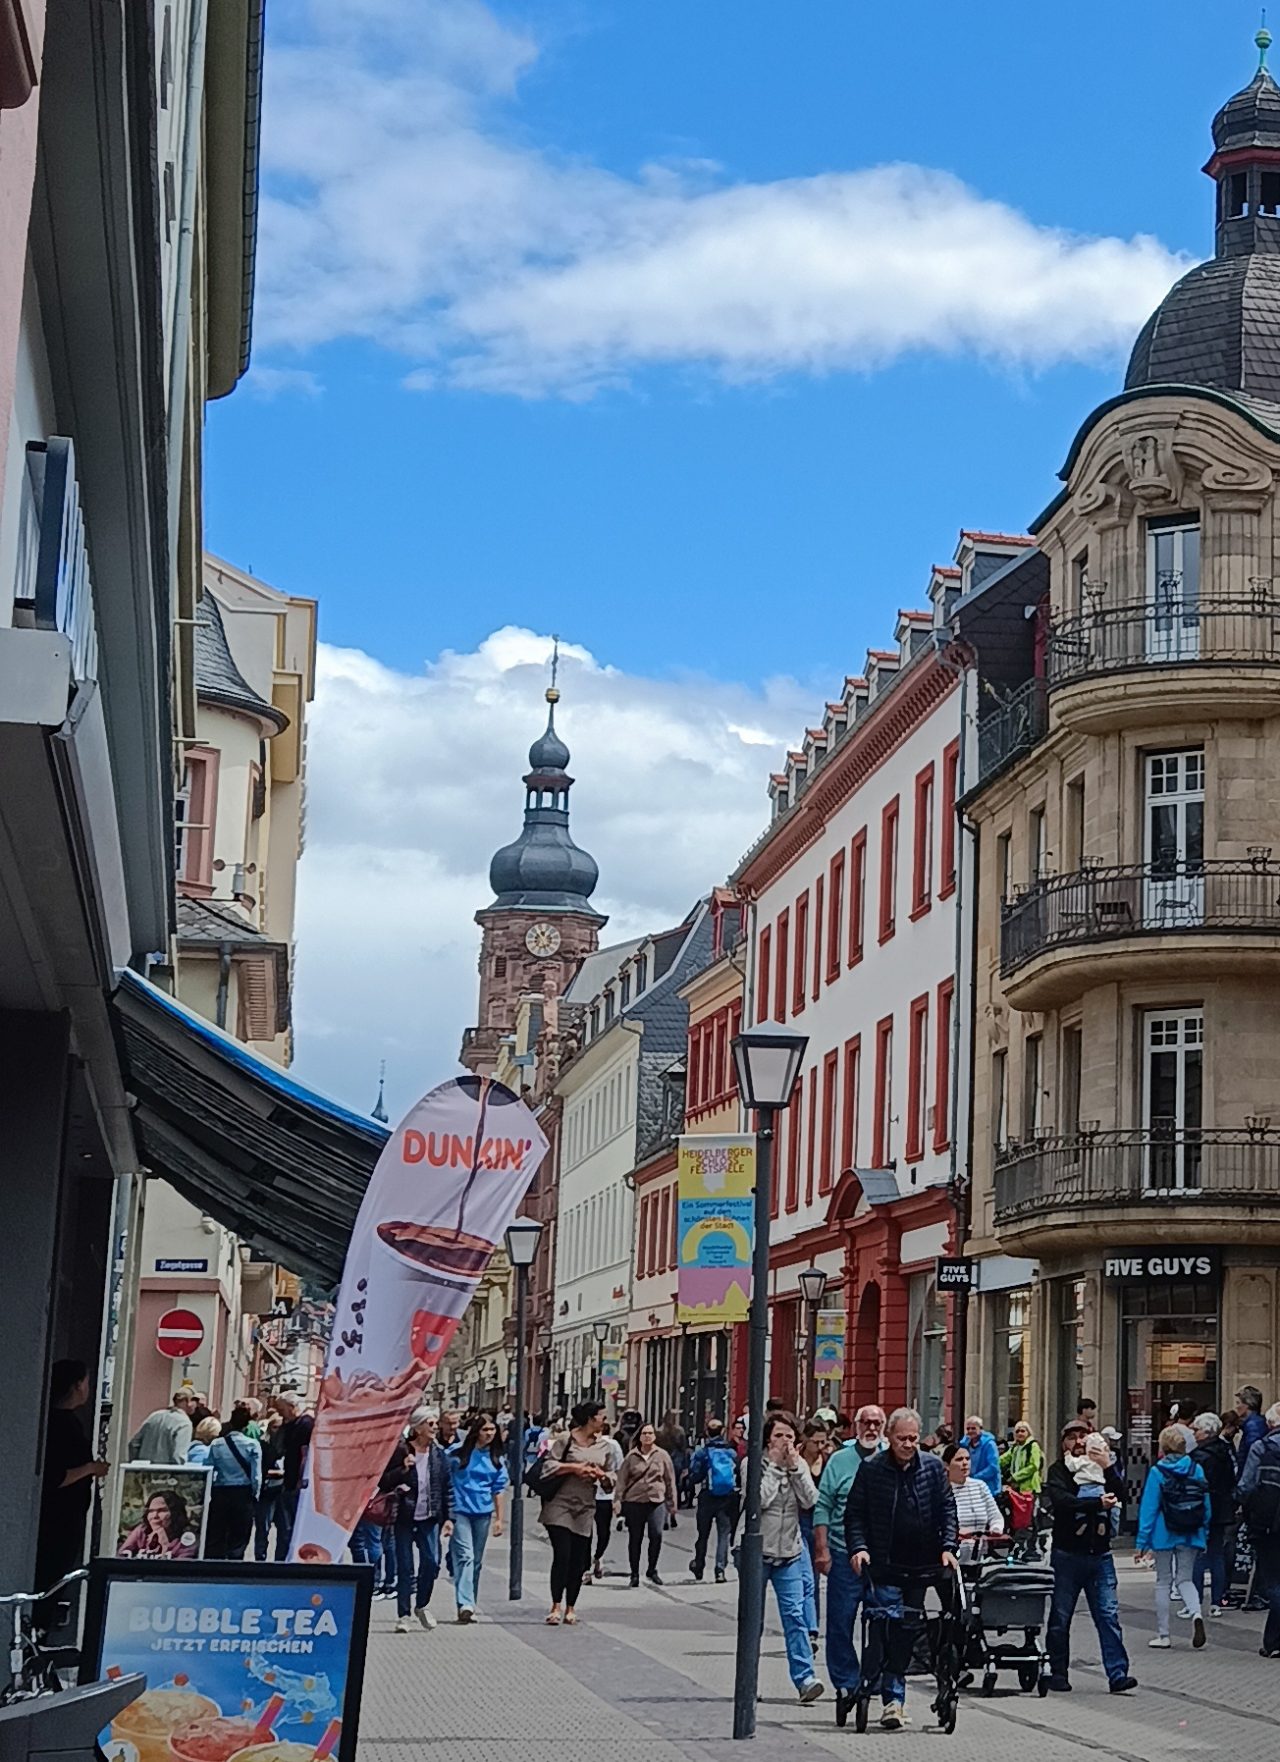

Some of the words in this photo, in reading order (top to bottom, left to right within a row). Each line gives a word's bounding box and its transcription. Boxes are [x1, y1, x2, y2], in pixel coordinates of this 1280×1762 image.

[403, 1129, 531, 1170] DUNKIN'
[682, 1147, 753, 1159] HEIDELBERGER
[690, 1164, 745, 1174] FESTSPIELE
[942, 1265, 967, 1274] FIVE
[1105, 1258, 1143, 1277] FIVE
[1147, 1256, 1212, 1276] GUYS
[940, 1273, 970, 1283] GUYS
[129, 1607, 262, 1634] BUBBLE
[271, 1609, 339, 1637] TEA
[151, 1638, 206, 1651] JETZT
[209, 1639, 315, 1654] ERFRISCHEN
